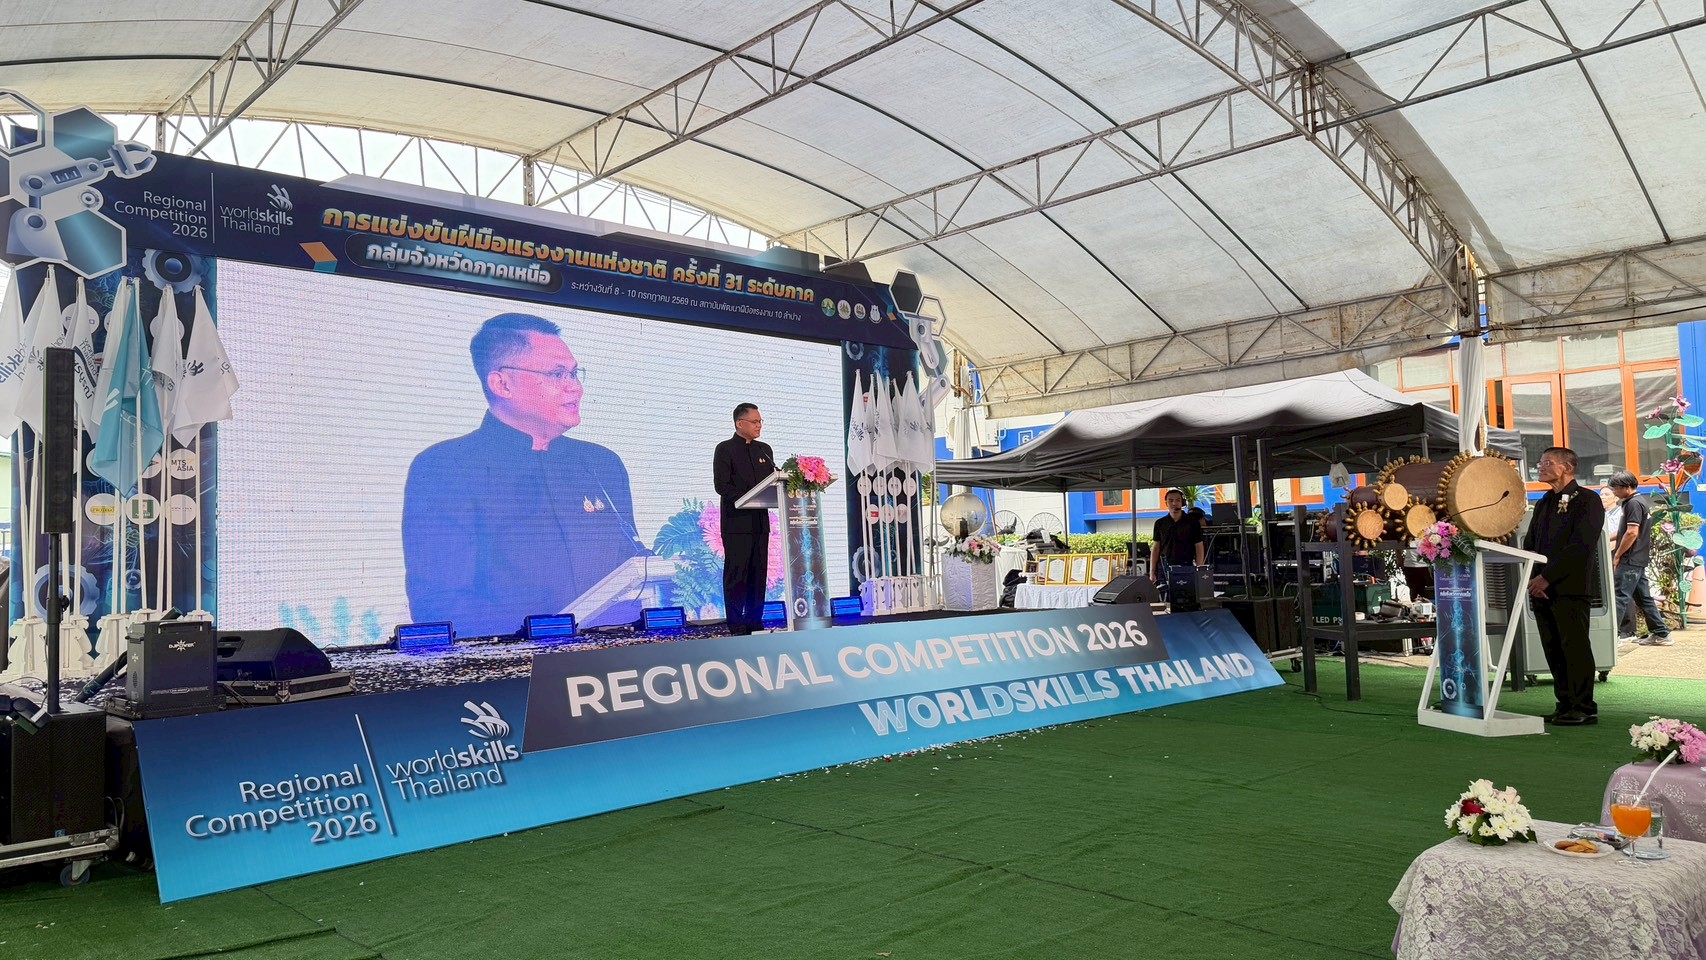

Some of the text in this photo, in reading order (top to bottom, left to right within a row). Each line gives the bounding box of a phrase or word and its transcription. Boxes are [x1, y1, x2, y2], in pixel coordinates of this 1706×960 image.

[114, 200, 207, 226] Competition
[143, 191, 207, 212] Regional
[219, 205, 293, 226] worldskills
[172, 223, 208, 239] 2026
[221, 216, 280, 236] Thailand
[323, 208, 815, 302] การแข่งขันฝีมือแรงงานแห่งชาติ ครั้งที่ 31 ระดับภาค
[366, 242, 550, 285] กลุ่มจังหวัดภาคเหนือ
[614, 287, 620, 296] 8
[627, 289, 637, 299] 10
[671, 295, 689, 306] 2569
[774, 310, 783, 320] 10
[1315, 616, 1330, 624] LED
[566, 620, 1148, 717] REGIONAL COMPETITION 2026
[858, 652, 1255, 737] WORLDSKILLS THAILAND
[385, 739, 520, 779] worldskills
[238, 763, 362, 803] Regional
[391, 764, 503, 801] Thailand
[184, 791, 369, 838] Competition
[306, 811, 377, 844] 2026
